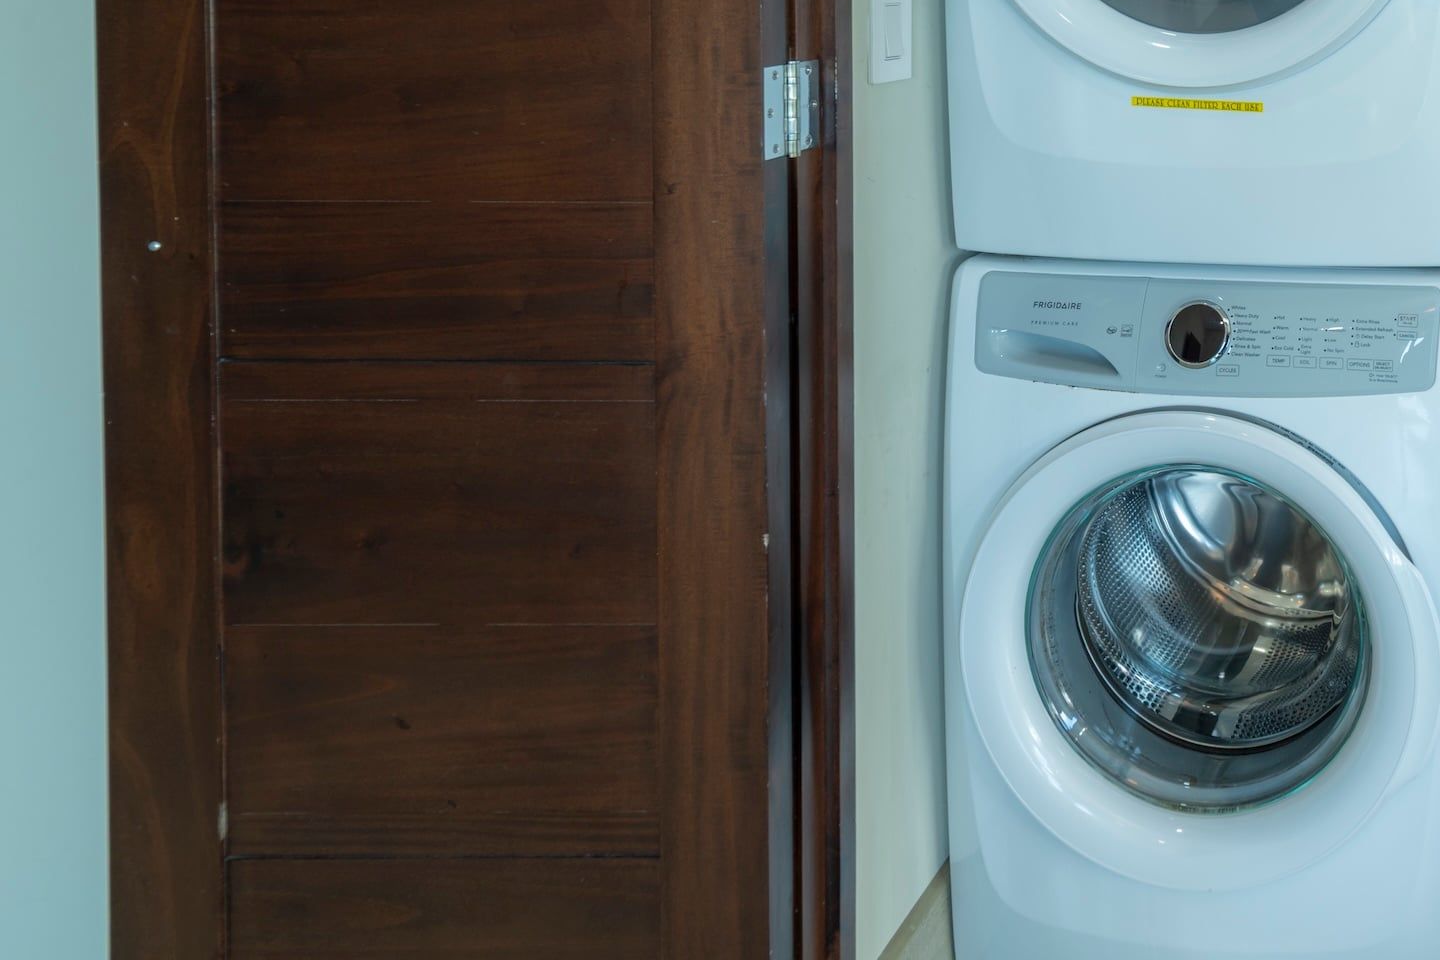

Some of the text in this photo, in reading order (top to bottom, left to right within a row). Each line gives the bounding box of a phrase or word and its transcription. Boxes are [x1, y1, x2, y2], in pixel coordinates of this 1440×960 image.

[1136, 97, 1260, 112] PLEASE CLEAN FILTER EACH USE
[1033, 301, 1082, 310] FRIGIDAIRE
